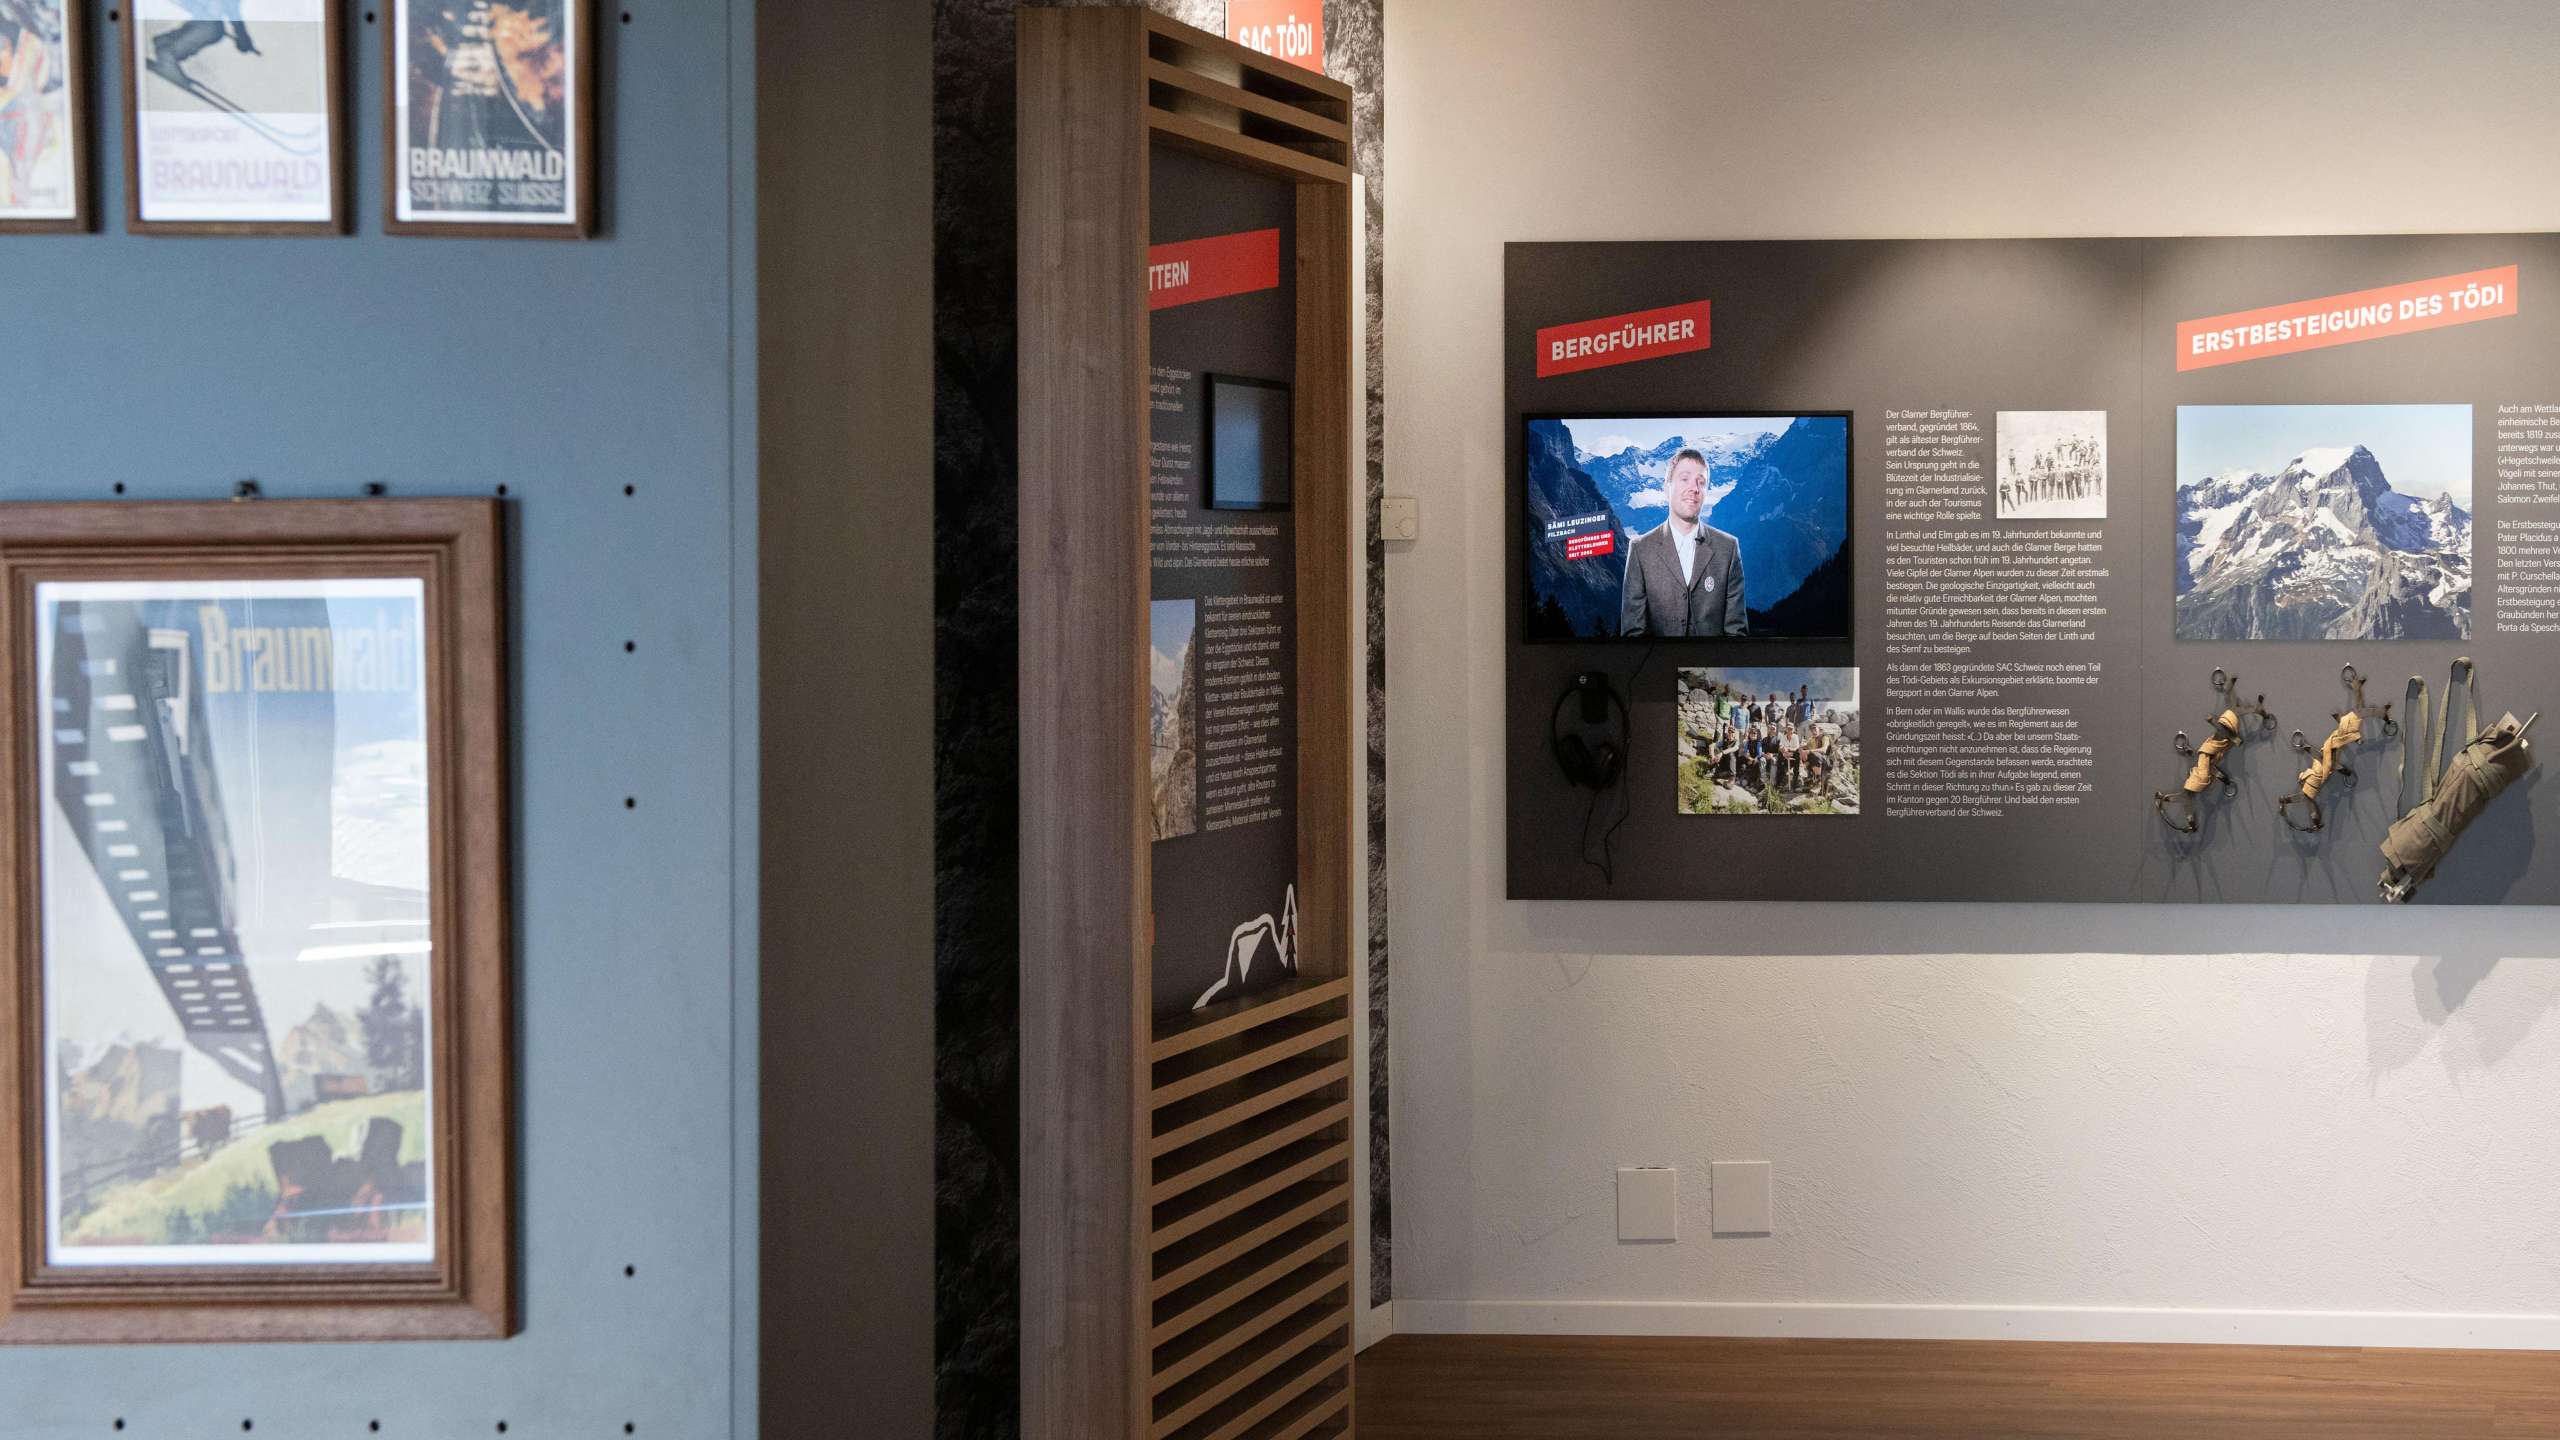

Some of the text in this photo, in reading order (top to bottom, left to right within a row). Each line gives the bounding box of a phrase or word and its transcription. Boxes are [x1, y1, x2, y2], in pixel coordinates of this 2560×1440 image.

[1239, 14, 1312, 58] SAC TÖDI
[410, 147, 564, 181] BRAUNWALD
[152, 159, 321, 189] BRAUNWALD
[411, 179, 561, 206] SCHWEIZ SUISSE
[2191, 283, 2504, 355] ERSTBESTEIGUNG DES TÖDI
[1551, 318, 1695, 361] BERGFÜHRER
[2499, 405, 2518, 414] Auch
[1886, 410, 1973, 421] Der Glarner Bergführer-
[1919, 422, 1957, 433] gegründet
[2498, 417, 2548, 427] einheimische
[2498, 430, 2525, 439] bereits
[2527, 430, 2543, 439] 1819
[1886, 435, 1983, 446] gilt als ältester Bergführer-
[1886, 448, 1916, 457] verband
[1918, 448, 1930, 457] der
[2498, 443, 2539, 454] unterwegs
[1886, 460, 1902, 470] Sein
[1904, 460, 1939, 471] Ursprung
[1940, 460, 1957, 471] geht
[1968, 460, 1979, 470] die
[1886, 473, 1984, 482] Blütezeit der Industrialisie-
[2498, 469, 2522, 480] Vögeli
[2524, 469, 2536, 478] mit
[1886, 487, 1903, 497] rung
[1916, 486, 1959, 495] Glarnerland
[2498, 482, 2536, 491] Johannes
[1895, 498, 1907, 507] der
[1909, 498, 1927, 507] auch
[1929, 498, 1942, 507] der
[1943, 498, 1981, 507] Tourismus
[2498, 495, 2531, 504] Salomon
[1886, 511, 1902, 520] eine
[1904, 511, 1934, 522] wichtige
[1936, 511, 1954, 520] Rolle
[1547, 520, 1566, 530] SÄMI
[2498, 520, 2510, 529] Die
[2498, 533, 2518, 542] Pater
[2520, 533, 2552, 542] Placidus
[2498, 546, 2517, 555] 1800
[2519, 546, 2550, 555] mehrere
[2498, 559, 2513, 568] Den
[2515, 559, 2541, 568] letzten
[2498, 571, 2510, 581] mit
[1926, 581, 1938, 590] Die
[1940, 581, 1984, 592] geologische
[2042, 581, 2075, 590] vielleicht
[2077, 581, 2094, 590] auch
[2498, 584, 2552, 595] Altersgründen
[2498, 597, 2555, 608] Erstbesteigung
[1887, 606, 1918, 616] mitunter
[1919, 606, 1947, 616] Gründe
[1949, 608, 1981, 617] gewesen
[2002, 606, 2019, 616] dass
[2020, 606, 2046, 616] bereits
[2056, 606, 2081, 616] diesen
[2082, 606, 2106, 616] ersten
[2497, 610, 2560, 619] Graubünden her
[1887, 619, 1912, 628] Jahren
[1914, 619, 1928, 628] des
[1940, 619, 1990, 628] Jahrhunderts
[1992, 619, 2026, 628] Reisende
[2027, 619, 2041, 628] das
[2042, 619, 2085, 628] Glarnerland
[2498, 623, 2518, 632] Porta
[199, 605, 413, 693] Braunwald
[1887, 663, 2100, 674] Als dann der 1863 gegründete SAC Schweiz noch einen Teil
[1887, 675, 1900, 685] des
[1950, 675, 1960, 685] als
[1962, 675, 2024, 686] Exkursionsgebiet
[2056, 675, 2085, 685] boomte
[2086, 675, 2098, 685] der
[1887, 688, 1922, 699] Bergsport
[1932, 688, 1946, 697] den
[1948, 688, 1975, 697] Glarner
[1898, 795, 1925, 804] Kanton
[1926, 797, 1949, 806] gegen
[2005, 795, 2020, 804] Und
[2022, 795, 2038, 804] bald
[2040, 795, 2054, 804] den
[2056, 795, 2079, 804] ersten
[1887, 807, 1956, 818] Bergführerverband
[1958, 807, 1970, 817] der
